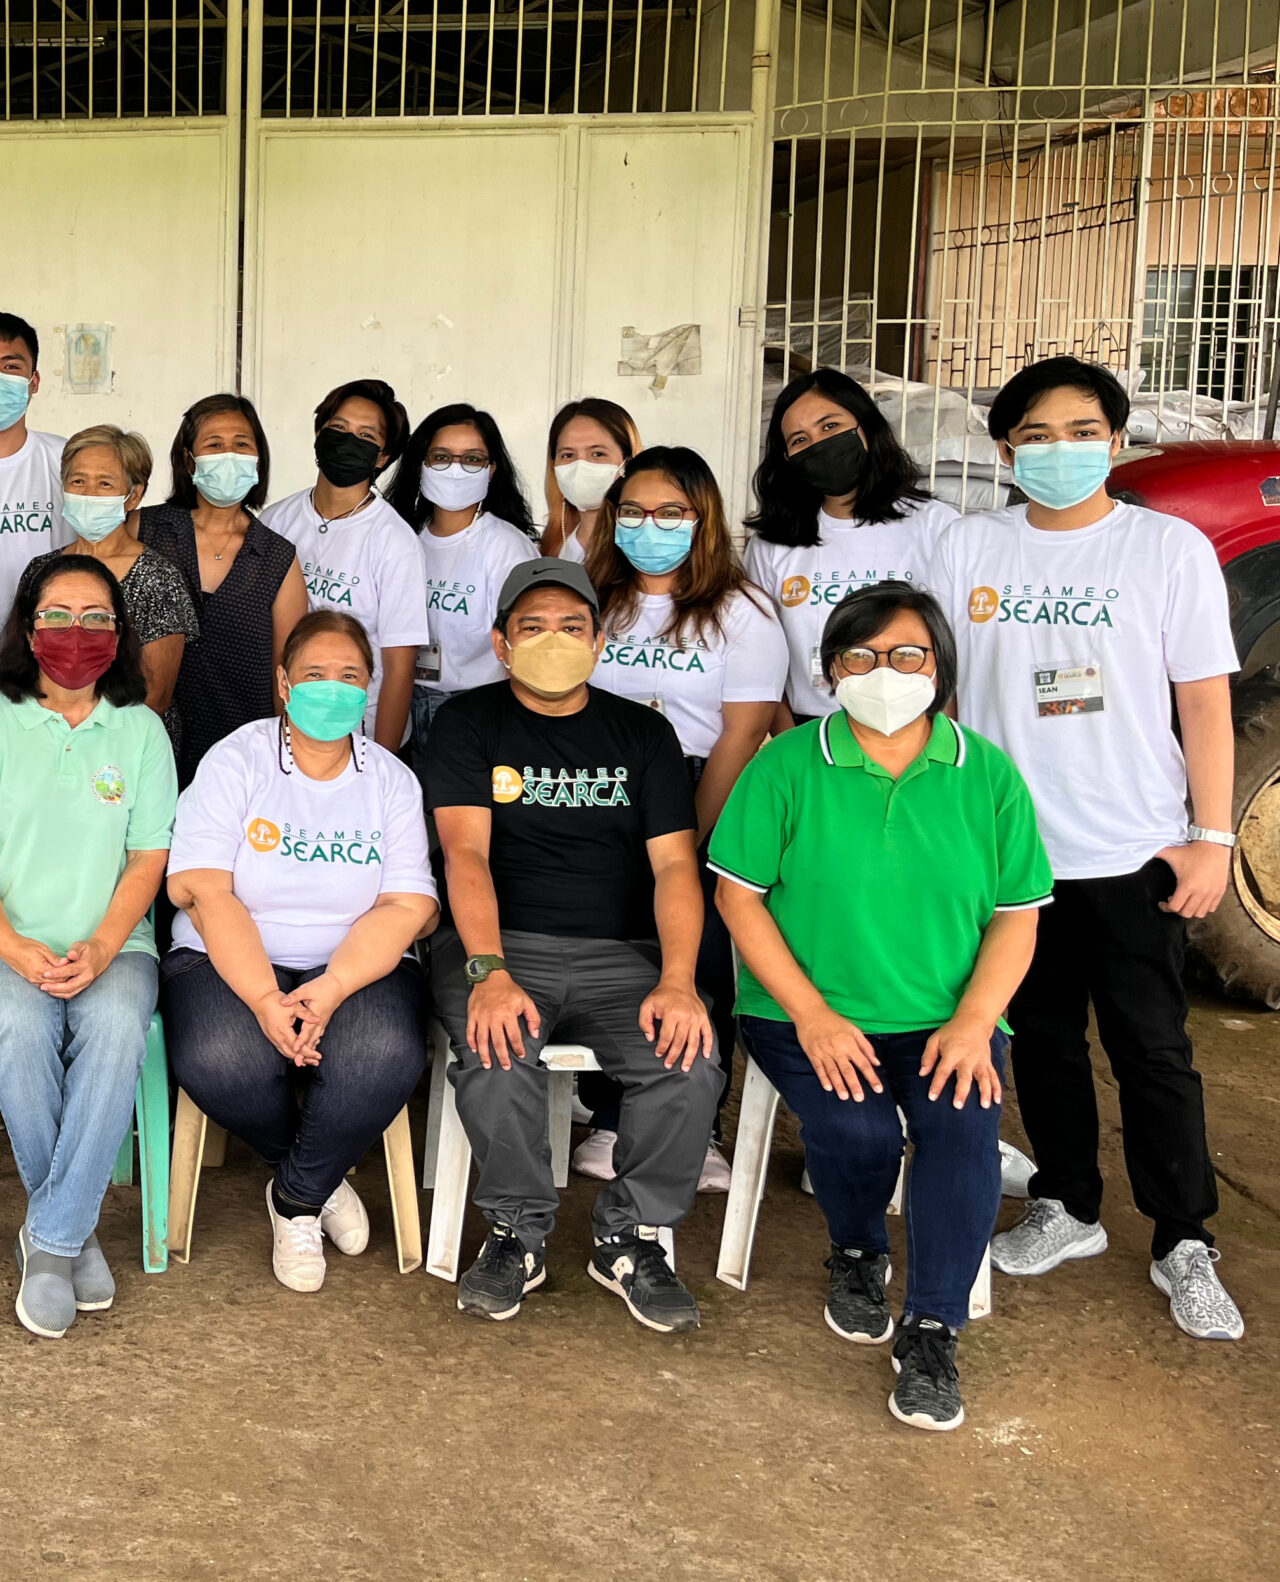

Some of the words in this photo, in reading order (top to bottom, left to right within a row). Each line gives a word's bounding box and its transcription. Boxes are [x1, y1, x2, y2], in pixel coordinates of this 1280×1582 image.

[304, 562, 360, 585] EAMEO
[813, 570, 913, 580] SEAMEO
[303, 573, 352, 607] ARCA
[426, 579, 476, 593] AMEO
[810, 583, 871, 606] SEA
[1002, 584, 1120, 599] SEAMEO
[428, 591, 469, 616] RCA
[998, 599, 1114, 628] SEARCA
[601, 644, 705, 674] SEARCA
[522, 766, 629, 781] SEAMEO
[522, 779, 631, 808] SEARCA
[284, 823, 382, 841] SEAMEO
[280, 836, 382, 865] SEARCA
